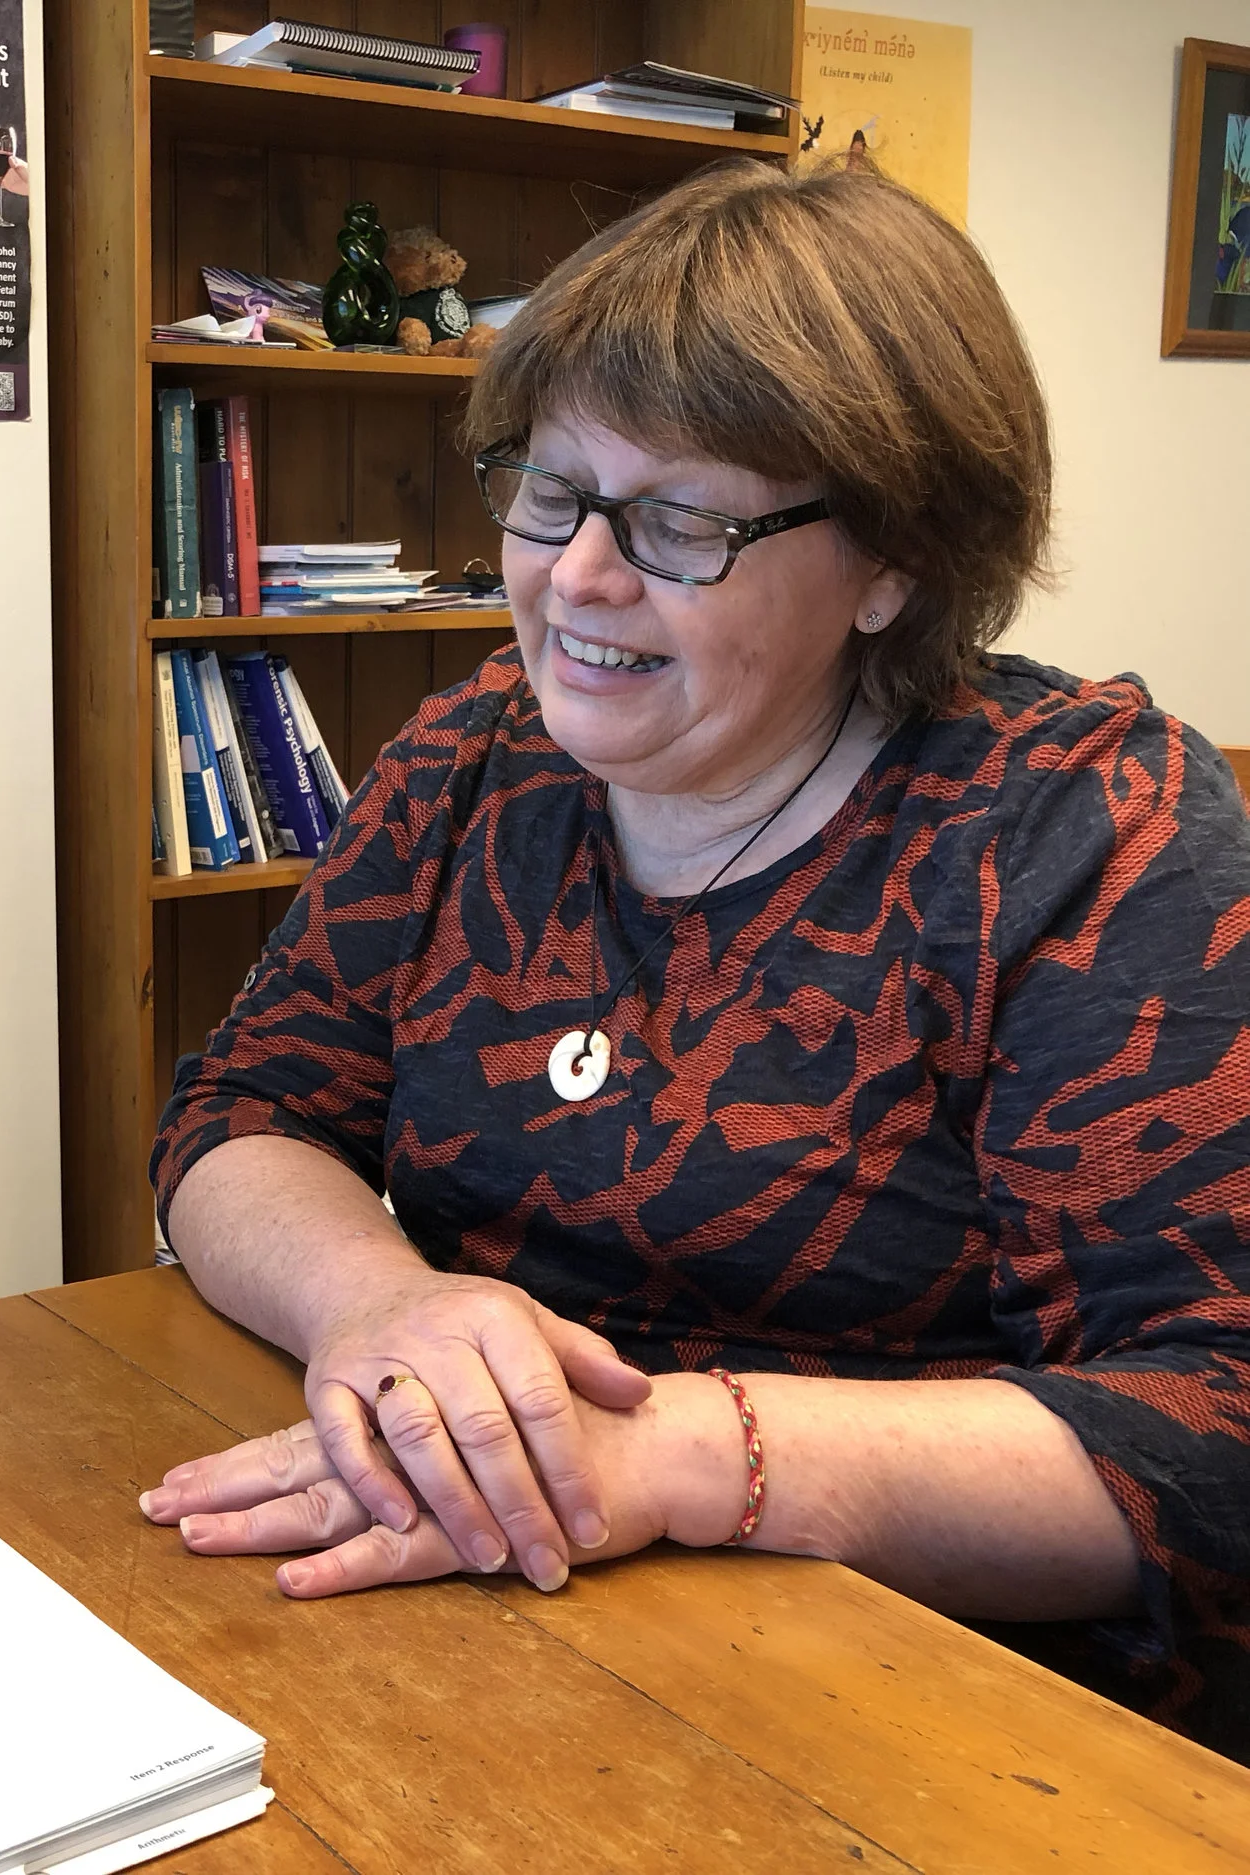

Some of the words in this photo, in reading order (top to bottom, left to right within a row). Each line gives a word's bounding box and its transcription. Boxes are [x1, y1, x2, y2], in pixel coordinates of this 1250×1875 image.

[820, 65, 850, 79] (Listen
[852, 70, 866, 83] my
[868, 71, 894, 84] child)
[6, 325, 15, 334] to
[217, 410, 225, 434] HARD
[218, 436, 226, 446] TO
[218, 448, 227, 463] PLA
[241, 455, 248, 463] OF
[175, 463, 184, 517] Administration
[177, 519, 185, 533] and
[177, 534, 185, 563] Scoring
[178, 563, 186, 591] Manual
[227, 553, 235, 579] DSM-5
[267, 658, 288, 717] Forensic
[283, 717, 312, 794] Psychology
[129, 1768, 157, 1781] Item
[164, 1745, 215, 1768] Response
[137, 1828, 186, 1850] Arithmetic
